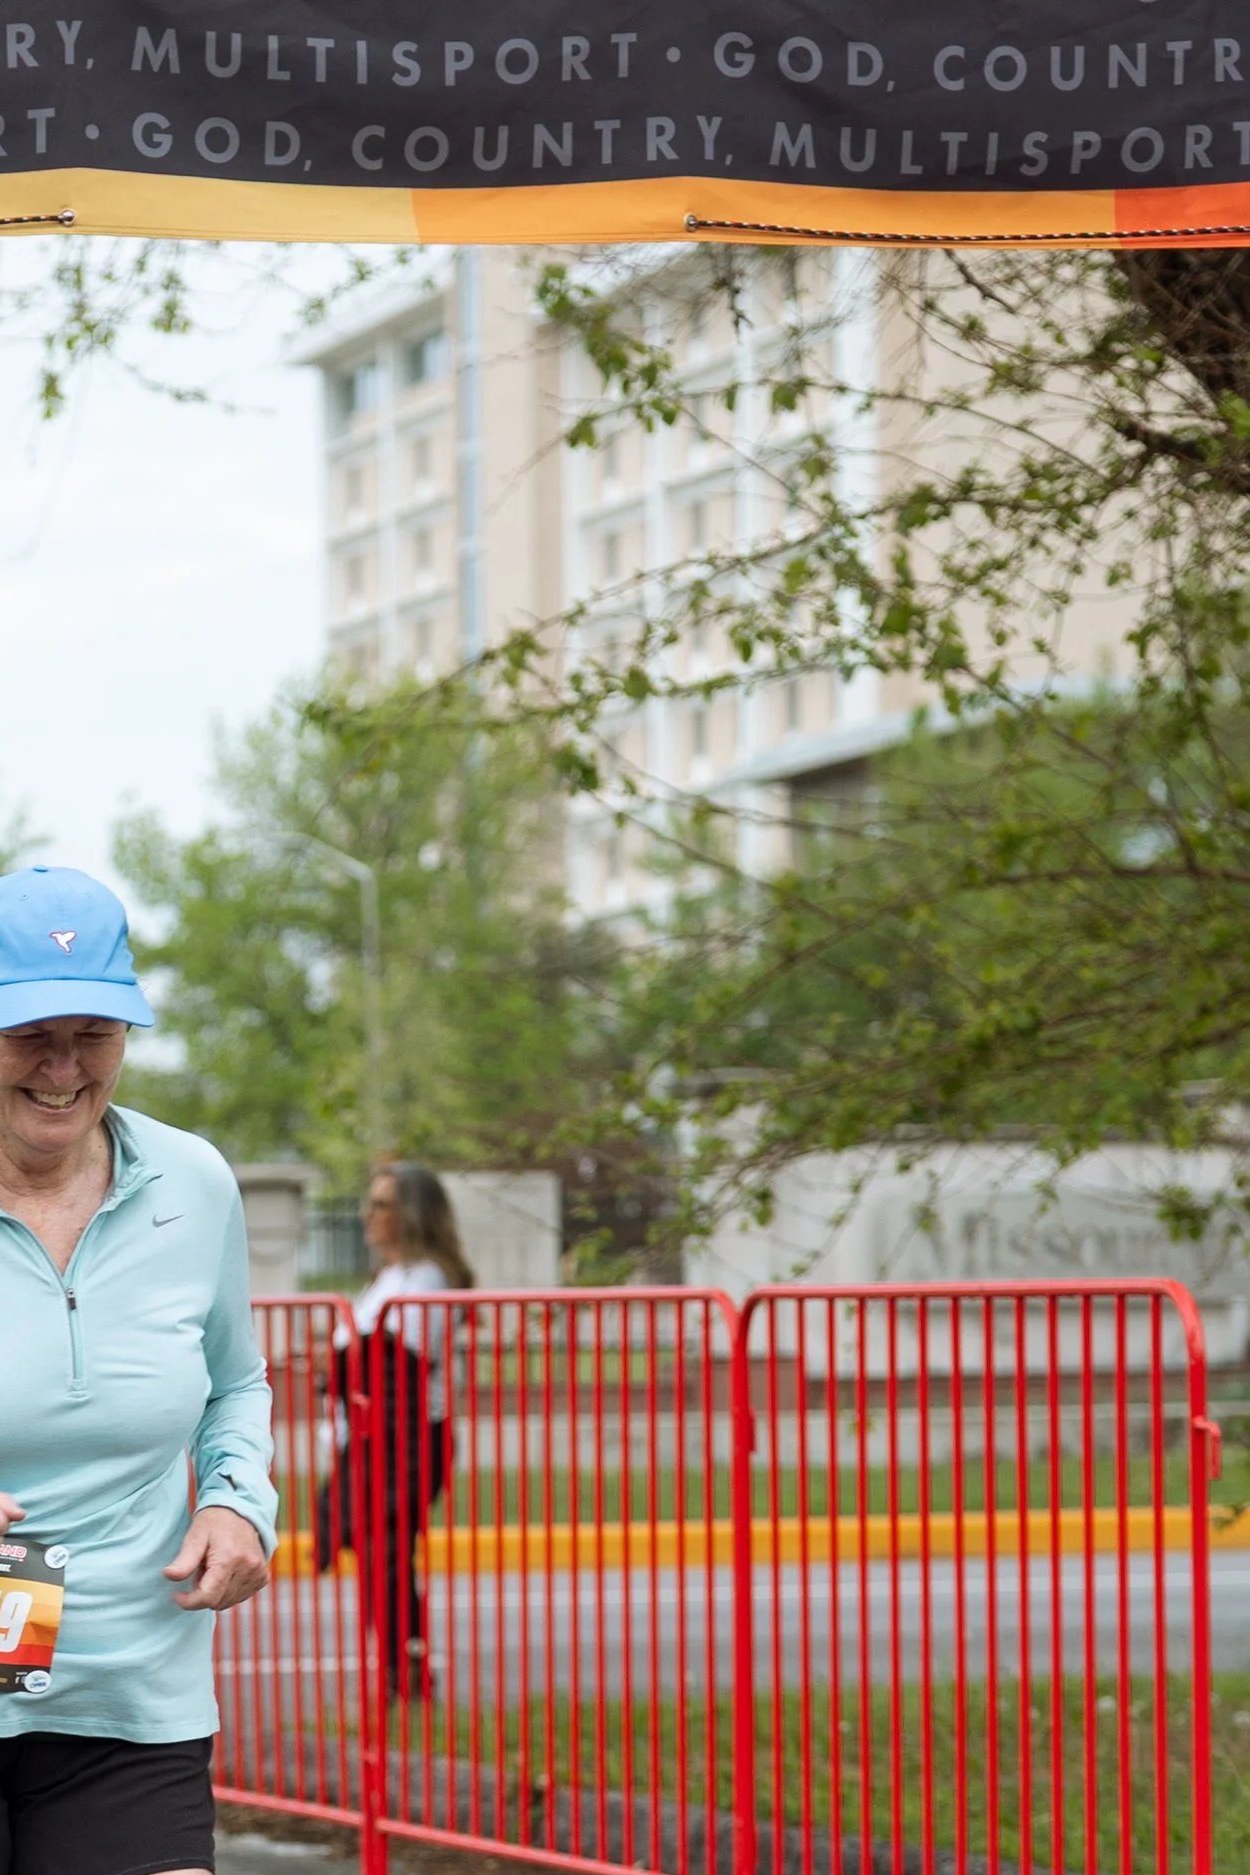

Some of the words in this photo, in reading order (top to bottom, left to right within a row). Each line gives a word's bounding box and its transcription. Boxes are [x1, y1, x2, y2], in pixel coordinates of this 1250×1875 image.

[131, 26, 638, 87] MULTISPORT
[713, 32, 896, 92] GOD,
[933, 38, 1245, 92] COUNTR
[131, 112, 313, 172] GOD,
[351, 116, 734, 172] COUNTRY,
